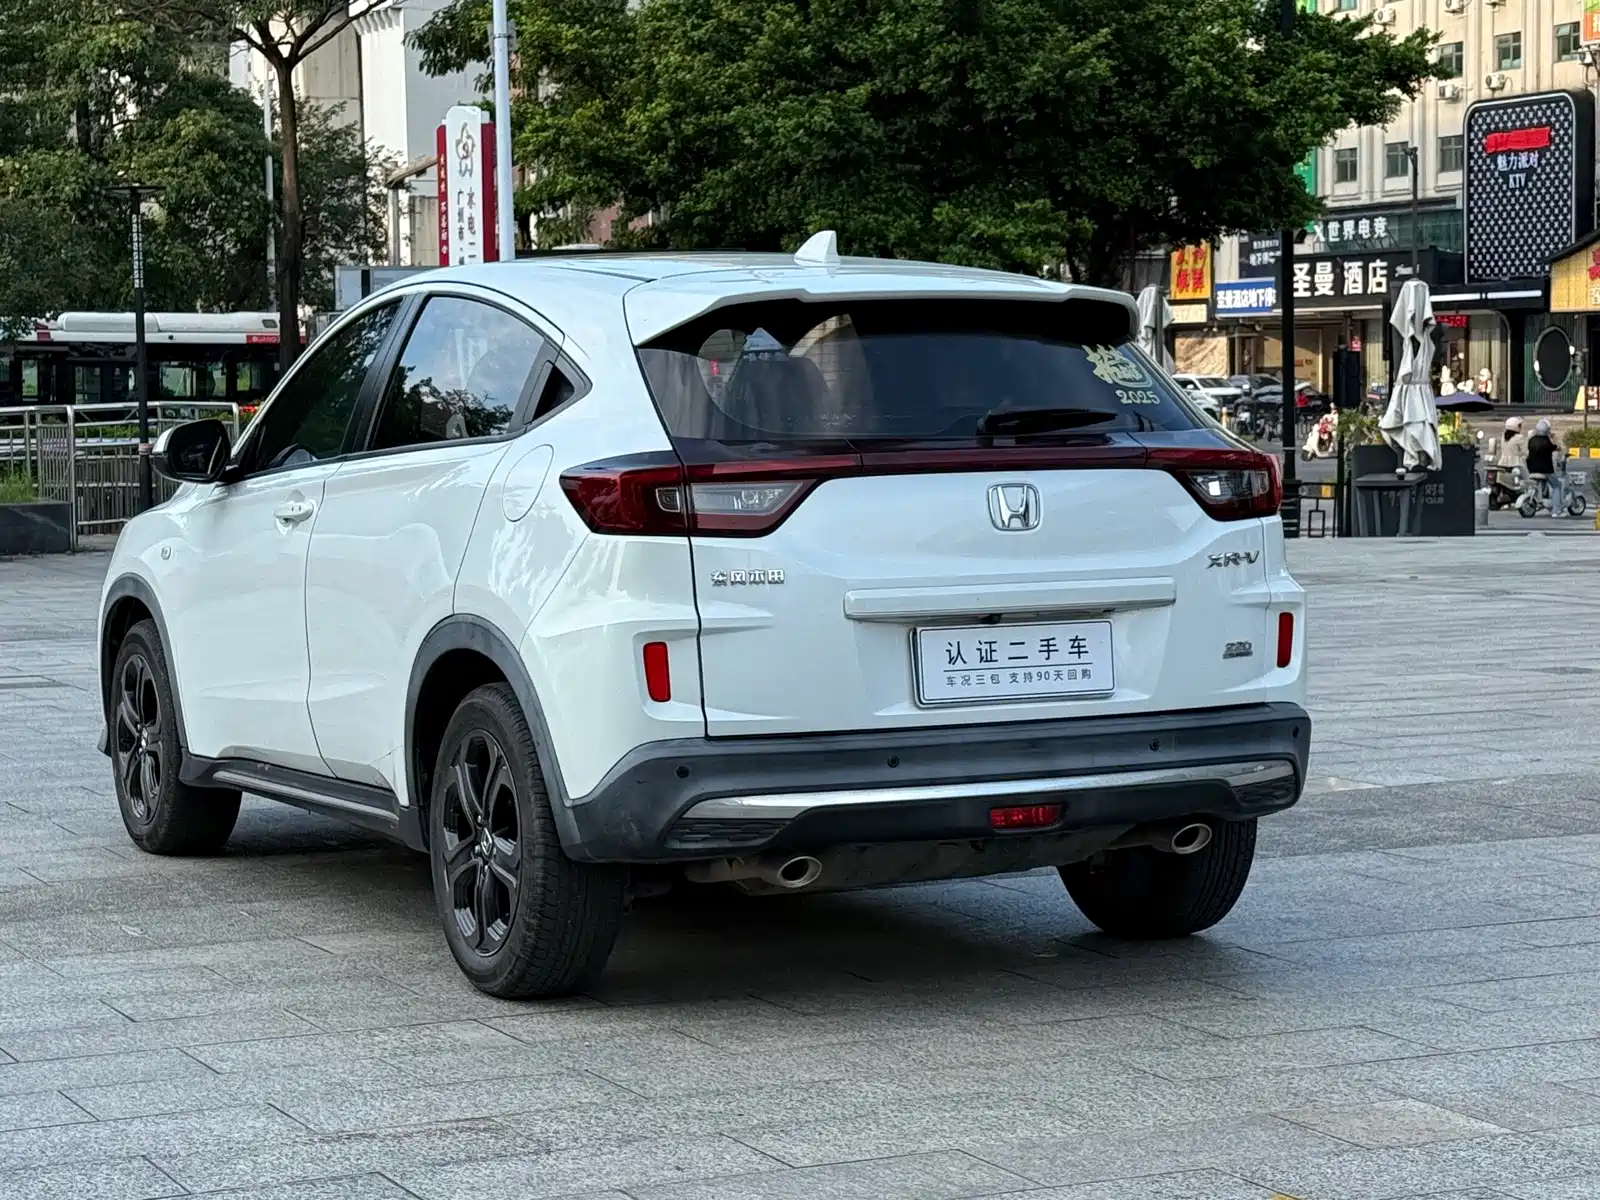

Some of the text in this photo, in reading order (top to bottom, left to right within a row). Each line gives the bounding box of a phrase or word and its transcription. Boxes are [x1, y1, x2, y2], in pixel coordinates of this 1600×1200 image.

[1508, 172, 1527, 189] KTV
[1115, 389, 1160, 405] 2025
[1206, 550, 1260, 569] XR-V
[710, 569, 785, 587] 东风本田
[945, 635, 1090, 666] 认证二手车
[945, 668, 1092, 688] 车况三包 支持90天回购
